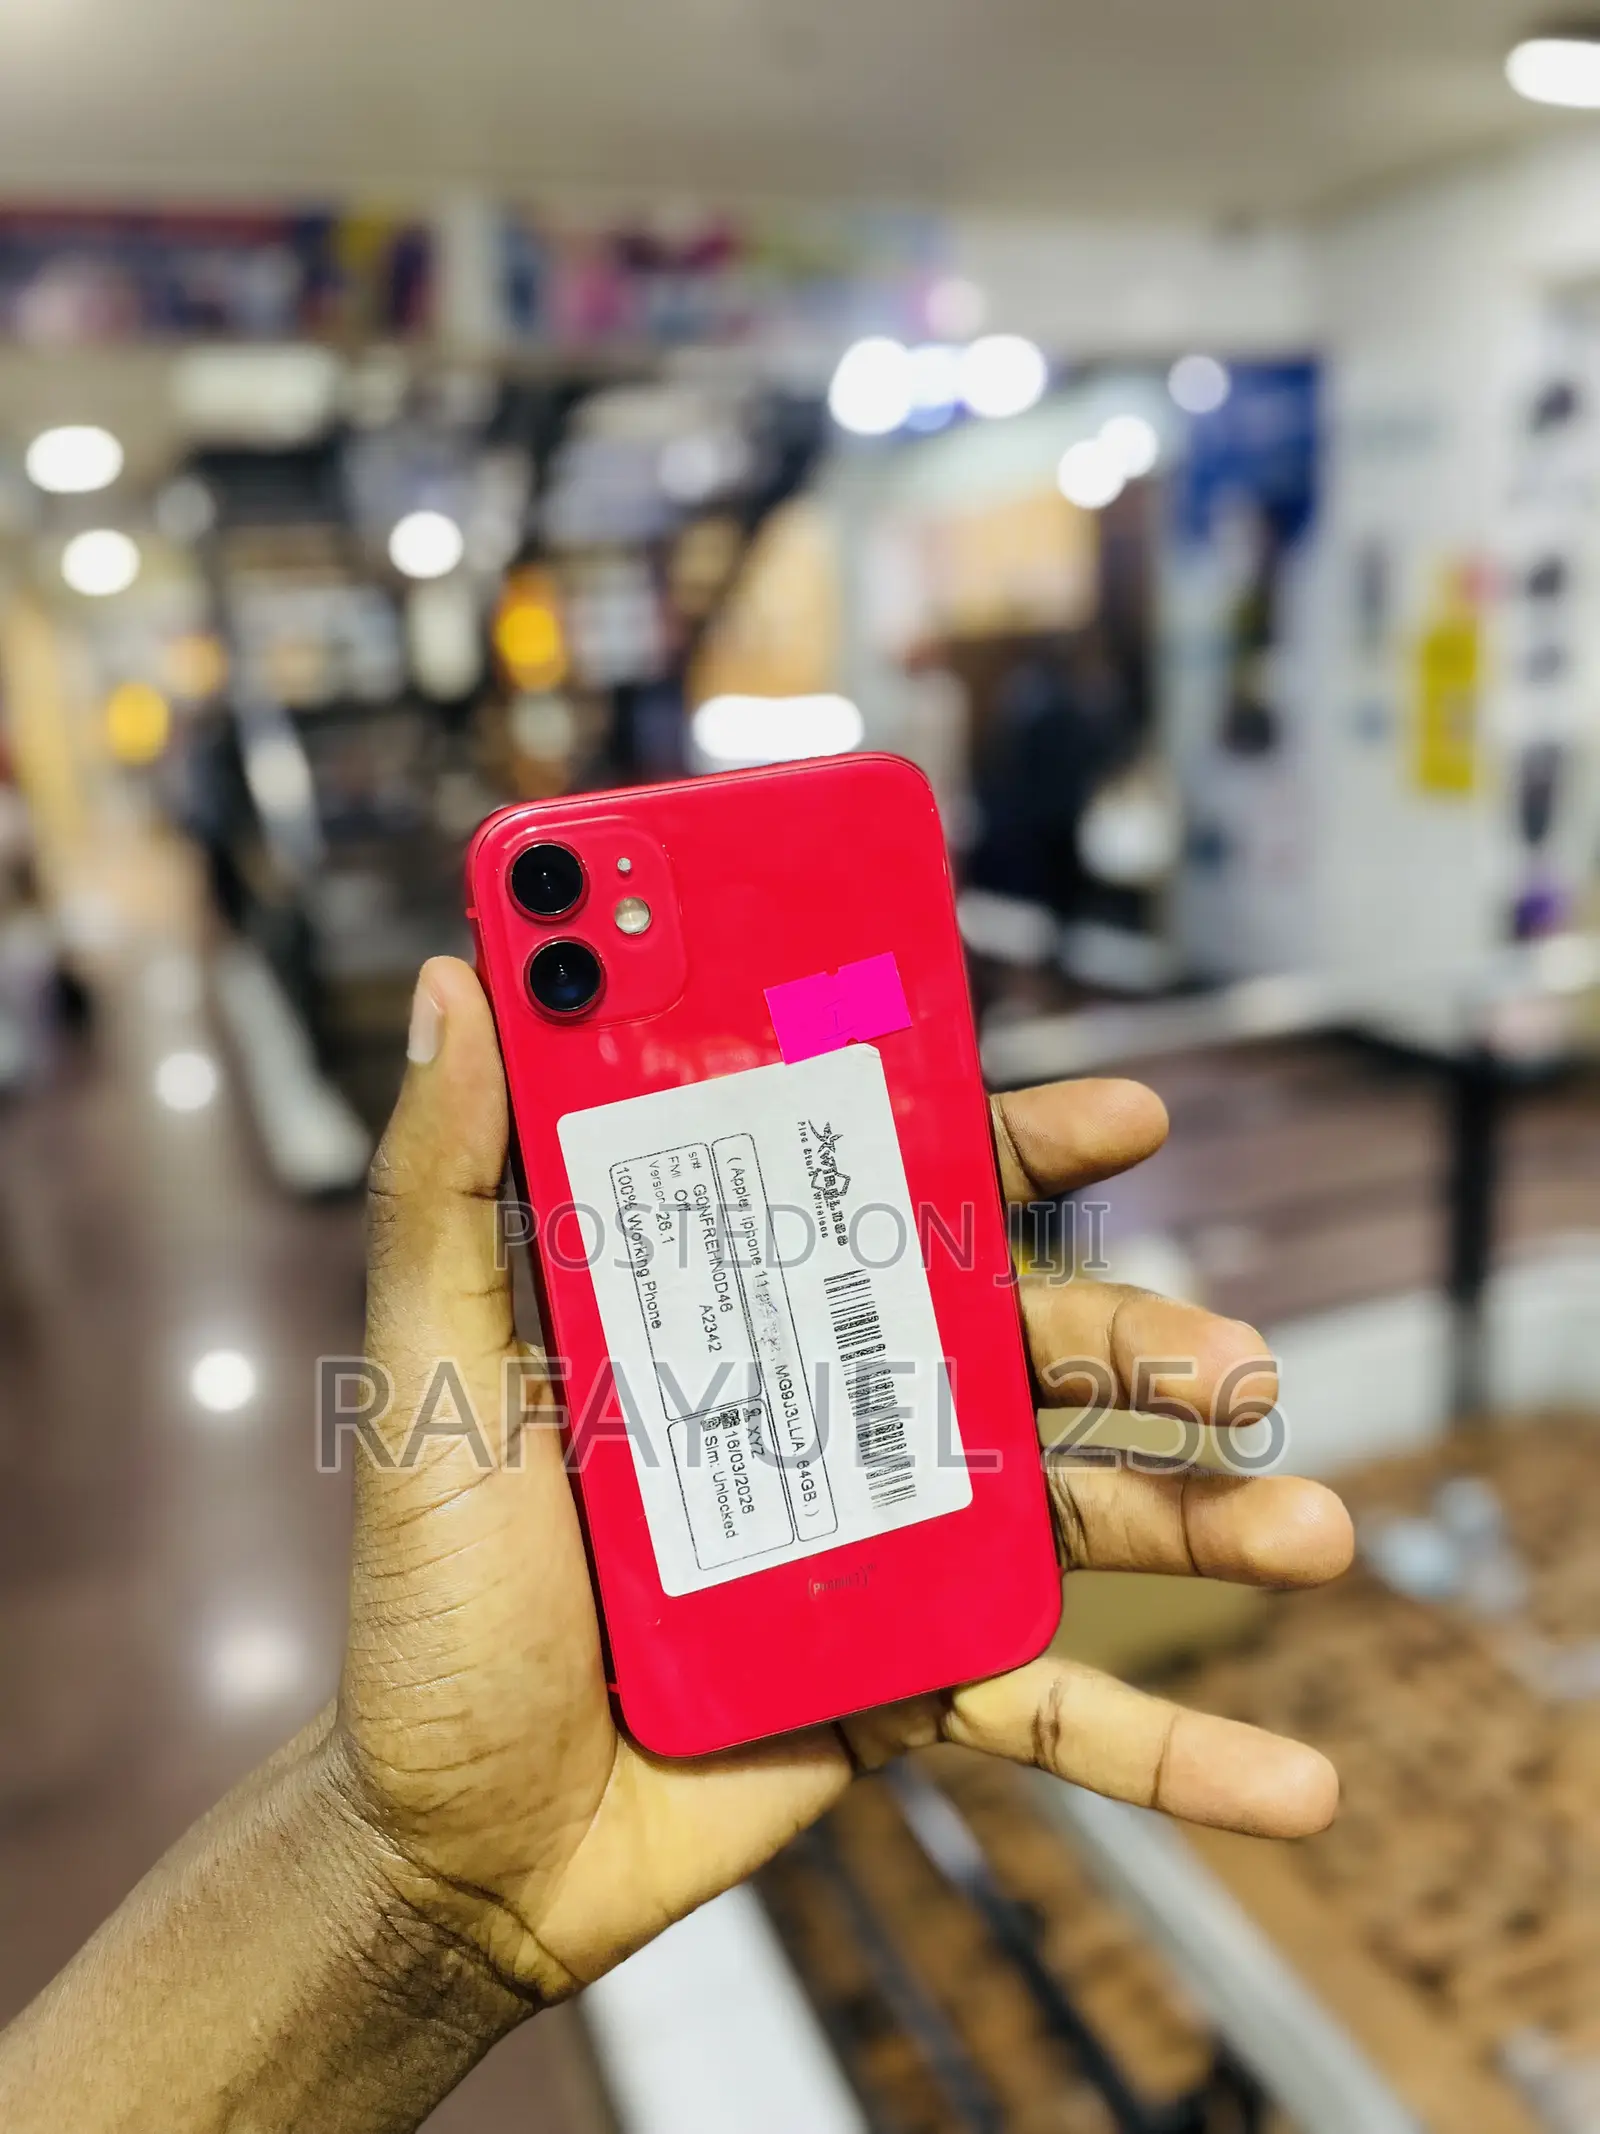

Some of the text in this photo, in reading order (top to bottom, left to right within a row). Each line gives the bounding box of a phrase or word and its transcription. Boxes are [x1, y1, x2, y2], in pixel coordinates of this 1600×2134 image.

[648, 1160, 666, 1204] Version
[668, 1156, 692, 1212] FMI Off
[616, 1167, 662, 1330] 100% Working Phone
[740, 1216, 762, 1266] iphone
[754, 1271, 769, 1288] 11
[699, 1305, 722, 1353] A2342
[725, 1432, 755, 1514] 16/03/2026
[746, 1425, 765, 1459] XYZ
[704, 1435, 739, 1538] Sim: Unlocked
